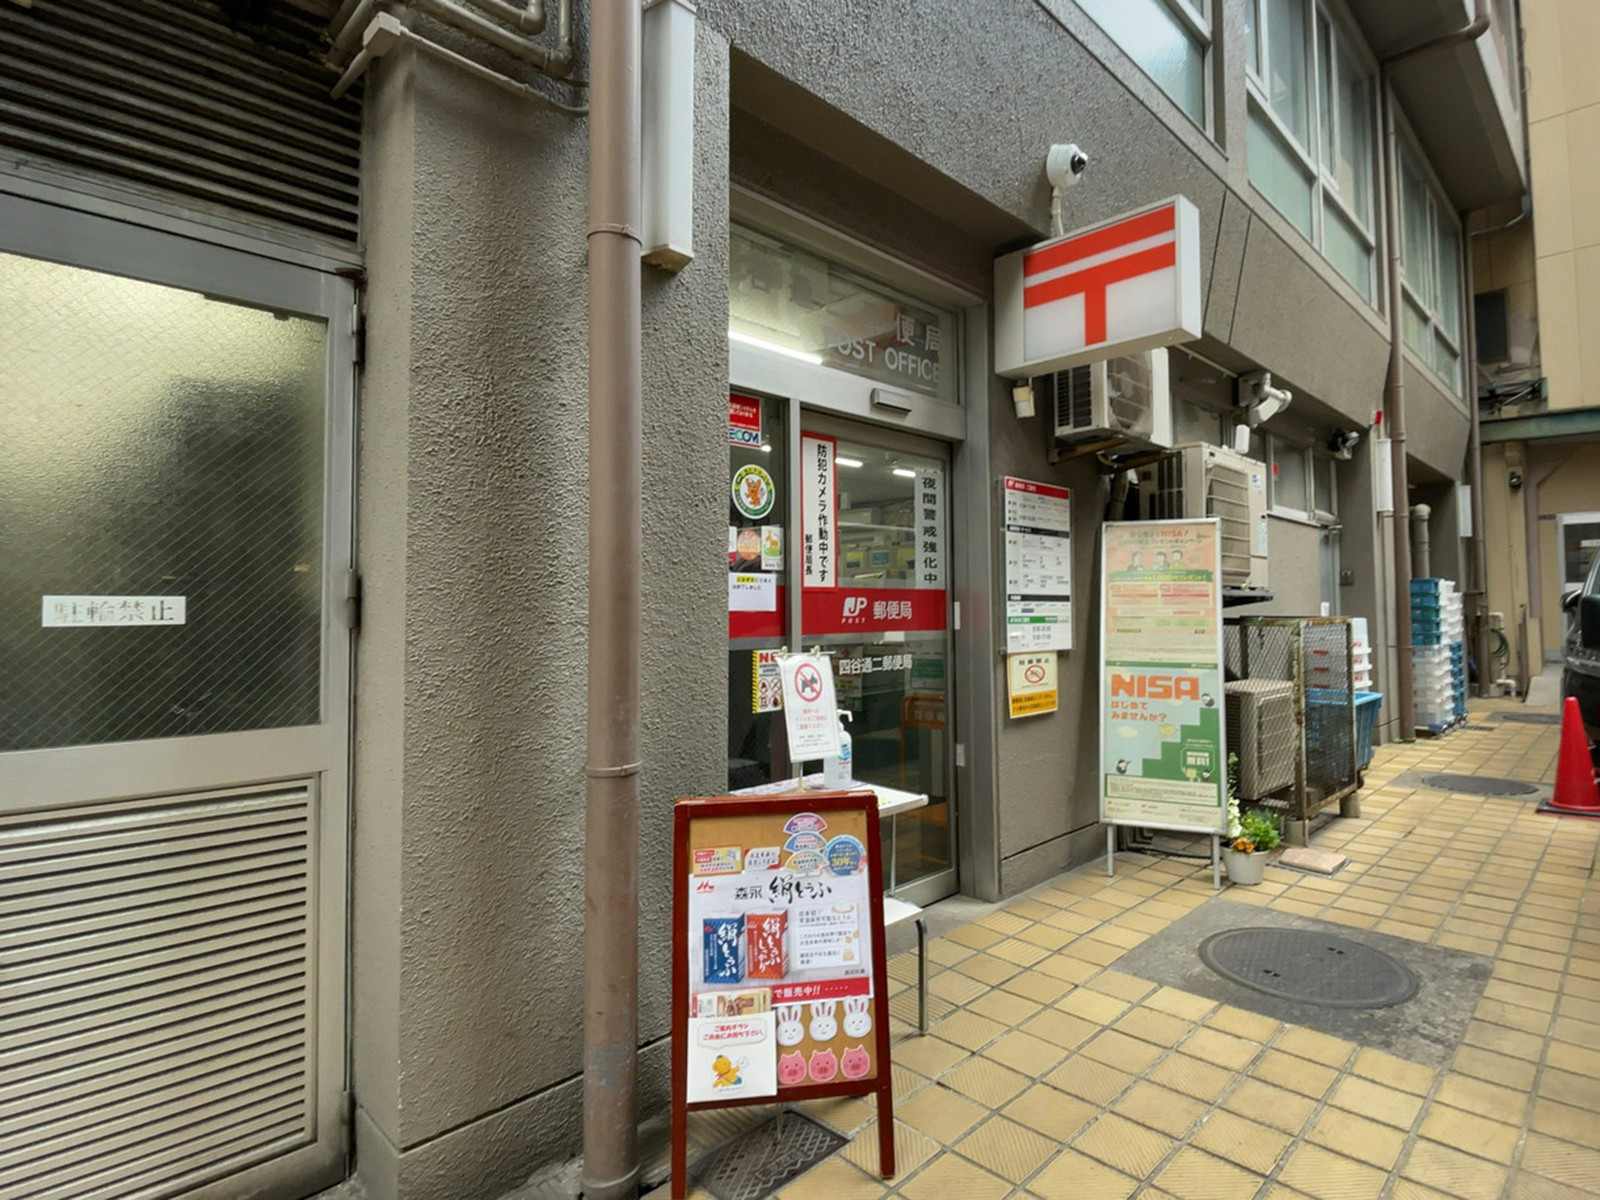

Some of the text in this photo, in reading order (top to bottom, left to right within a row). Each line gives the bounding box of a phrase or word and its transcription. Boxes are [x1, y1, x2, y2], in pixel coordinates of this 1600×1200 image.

[884, 346, 941, 382] OFFICE
[817, 443, 829, 583] 防犯カメラ作動中です
[922, 477, 938, 584] 夜間警戒強化中
[873, 600, 913, 620] 郵便局
[839, 654, 912, 675] 四谷通二郵便局
[1111, 674, 1200, 701] NISA
[1110, 712, 1167, 721] みませんか?
[1111, 701, 1149, 710] はじめて
[769, 875, 833, 904] 絹とうふ
